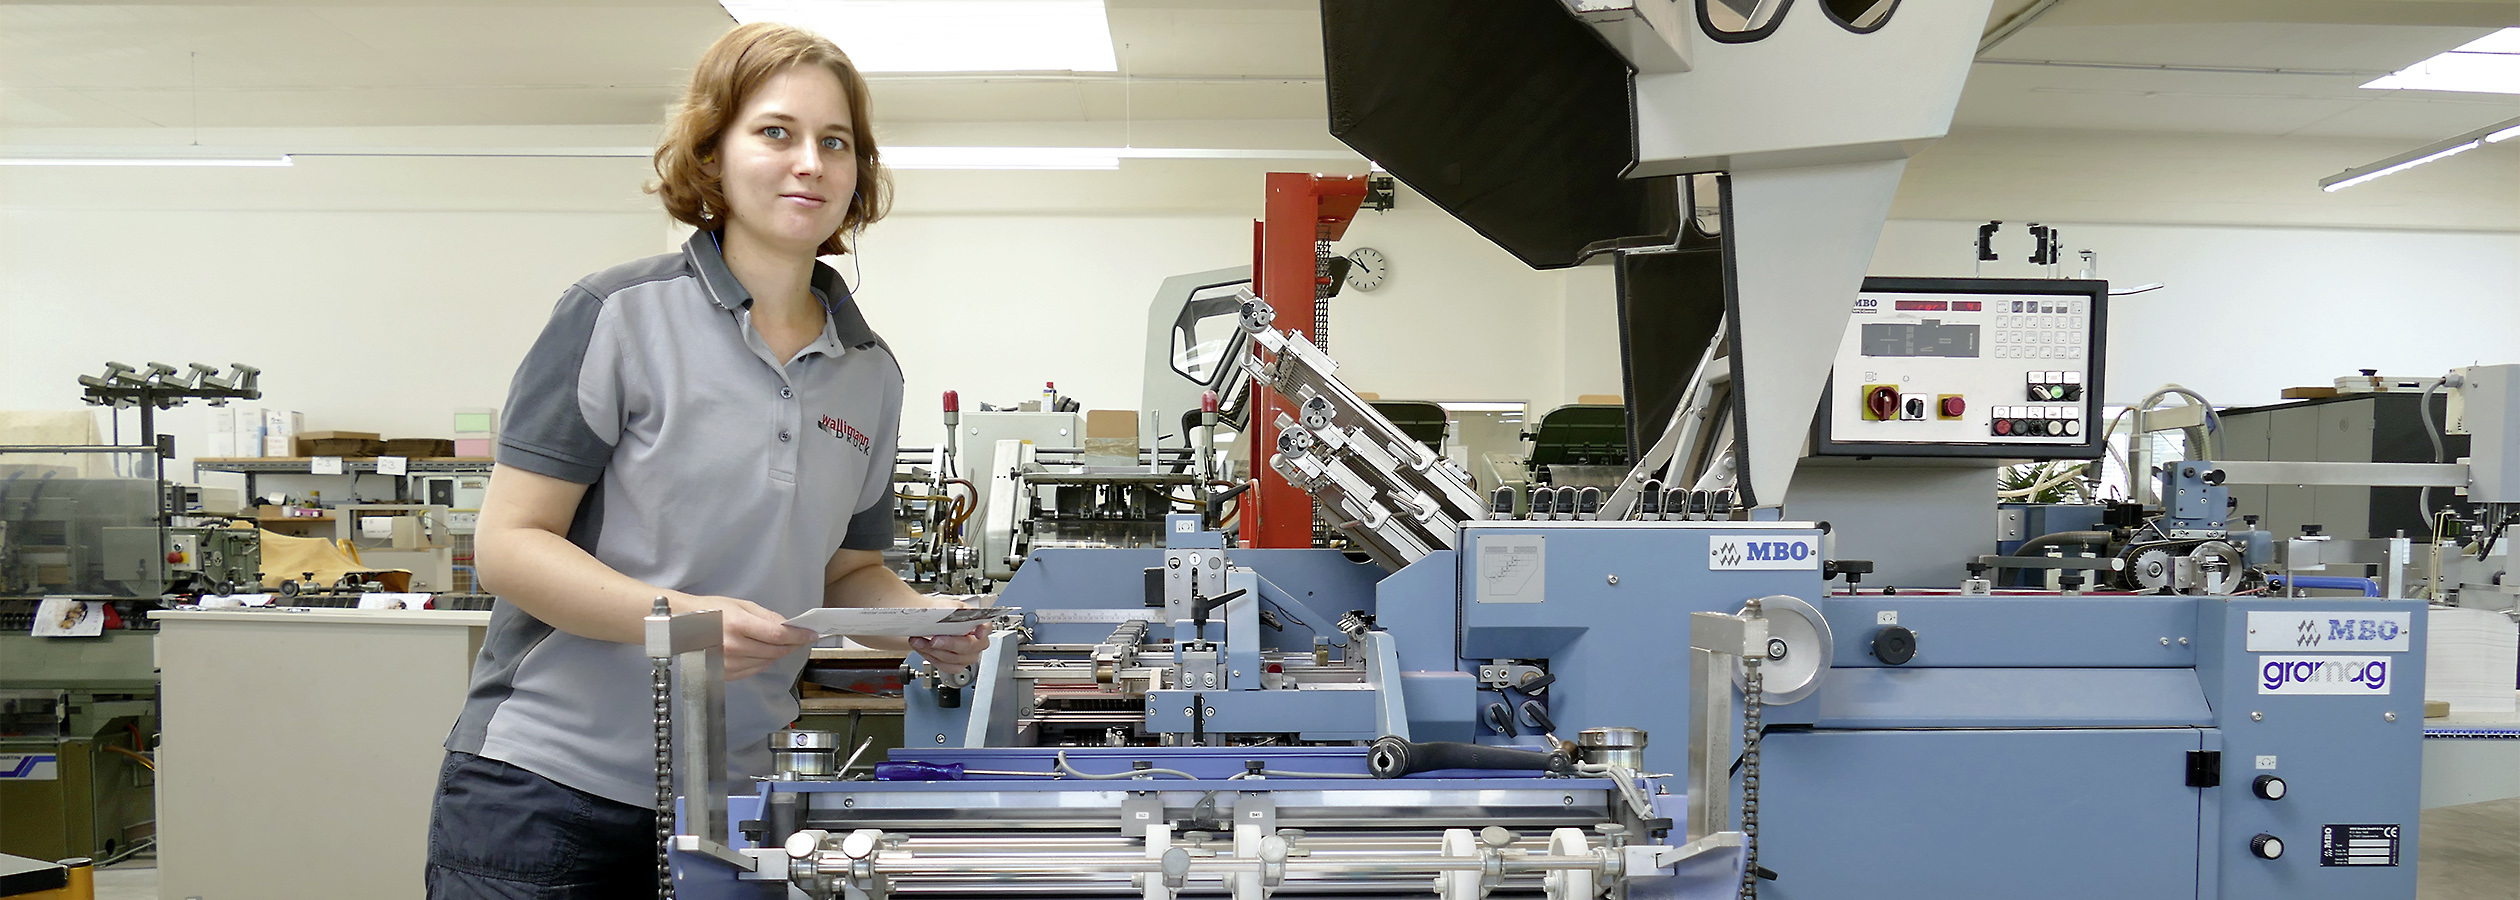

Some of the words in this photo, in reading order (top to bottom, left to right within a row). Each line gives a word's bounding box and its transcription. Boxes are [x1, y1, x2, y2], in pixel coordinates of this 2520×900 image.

[822, 414, 869, 446] wallimann
[1747, 541, 1809, 561] MBO
[2328, 619, 2398, 641] MBO
[2263, 661, 2387, 690] gramag
[2324, 827, 2332, 848] MBO
